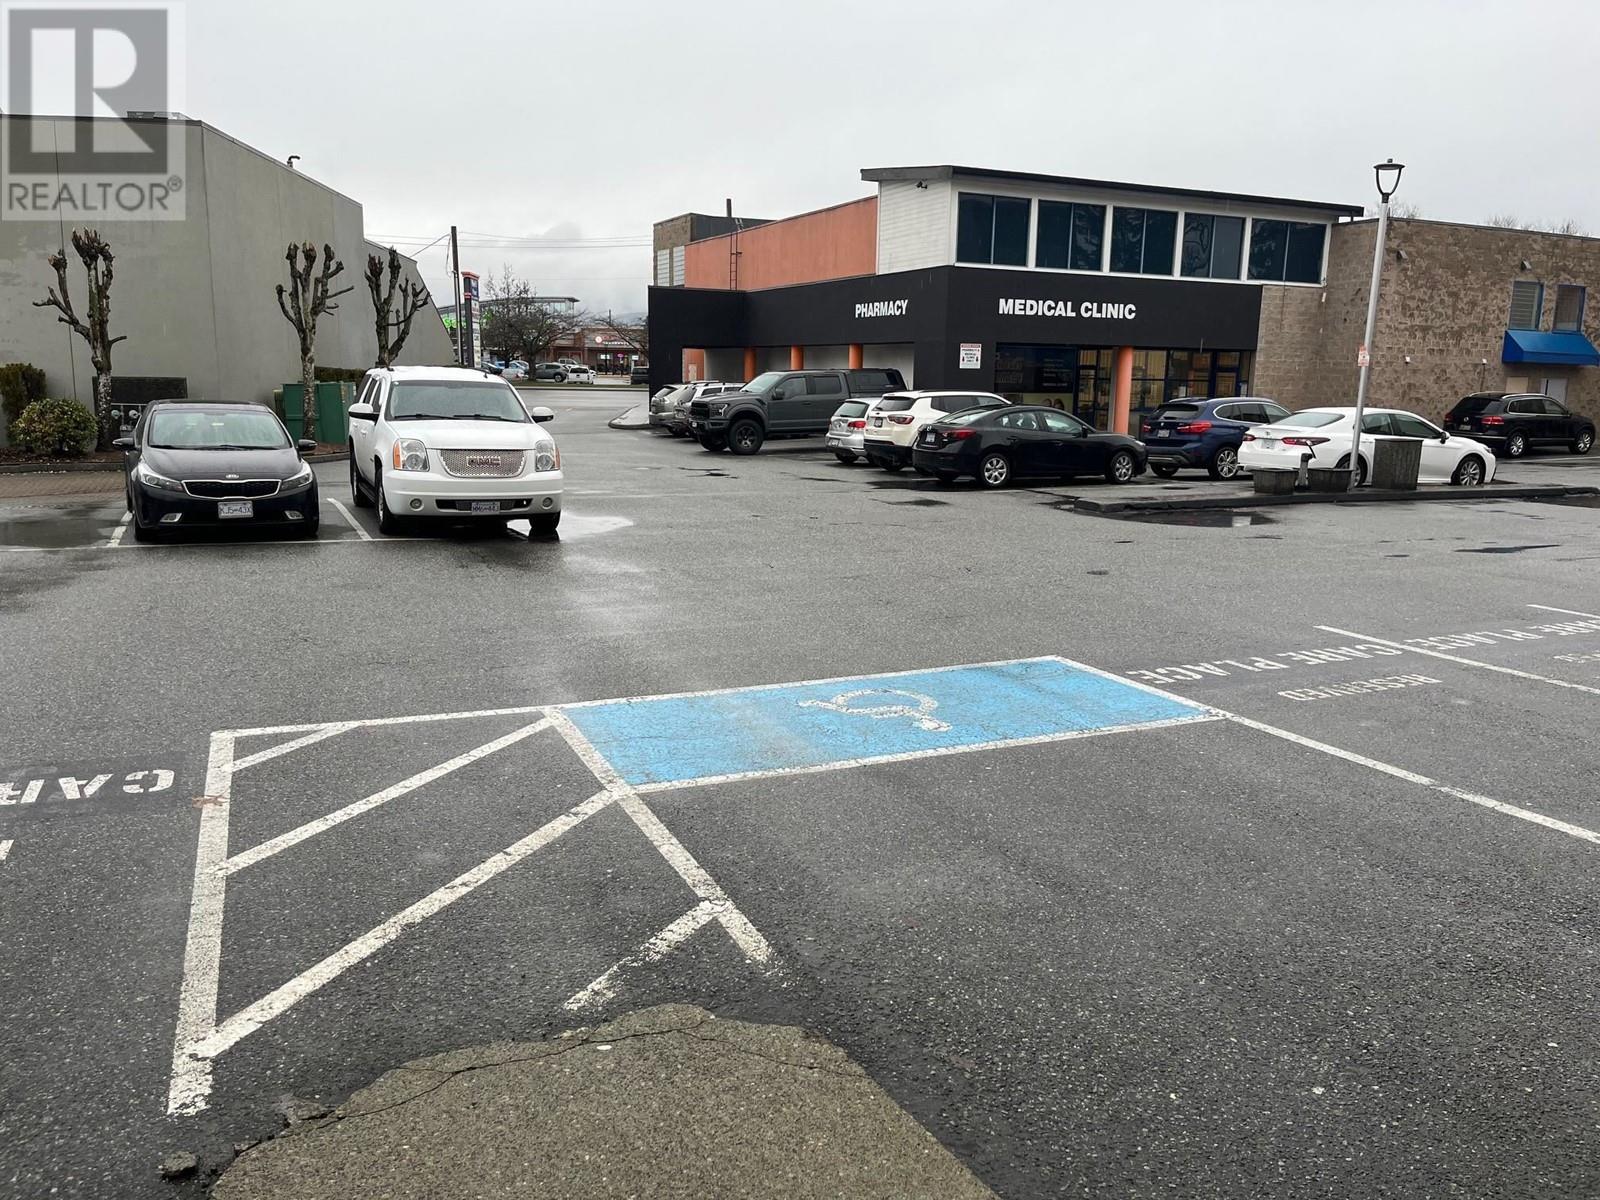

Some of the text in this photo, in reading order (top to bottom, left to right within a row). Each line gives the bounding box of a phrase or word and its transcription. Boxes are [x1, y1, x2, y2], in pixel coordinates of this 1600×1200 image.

[855, 299, 908, 318] PHARMACY
[999, 298, 1136, 320] MEDICAL CLINIC
[1403, 629, 1544, 650] PLACE
[1125, 644, 1403, 684] CARE PLACE
[1277, 674, 1443, 701] RESERVED
